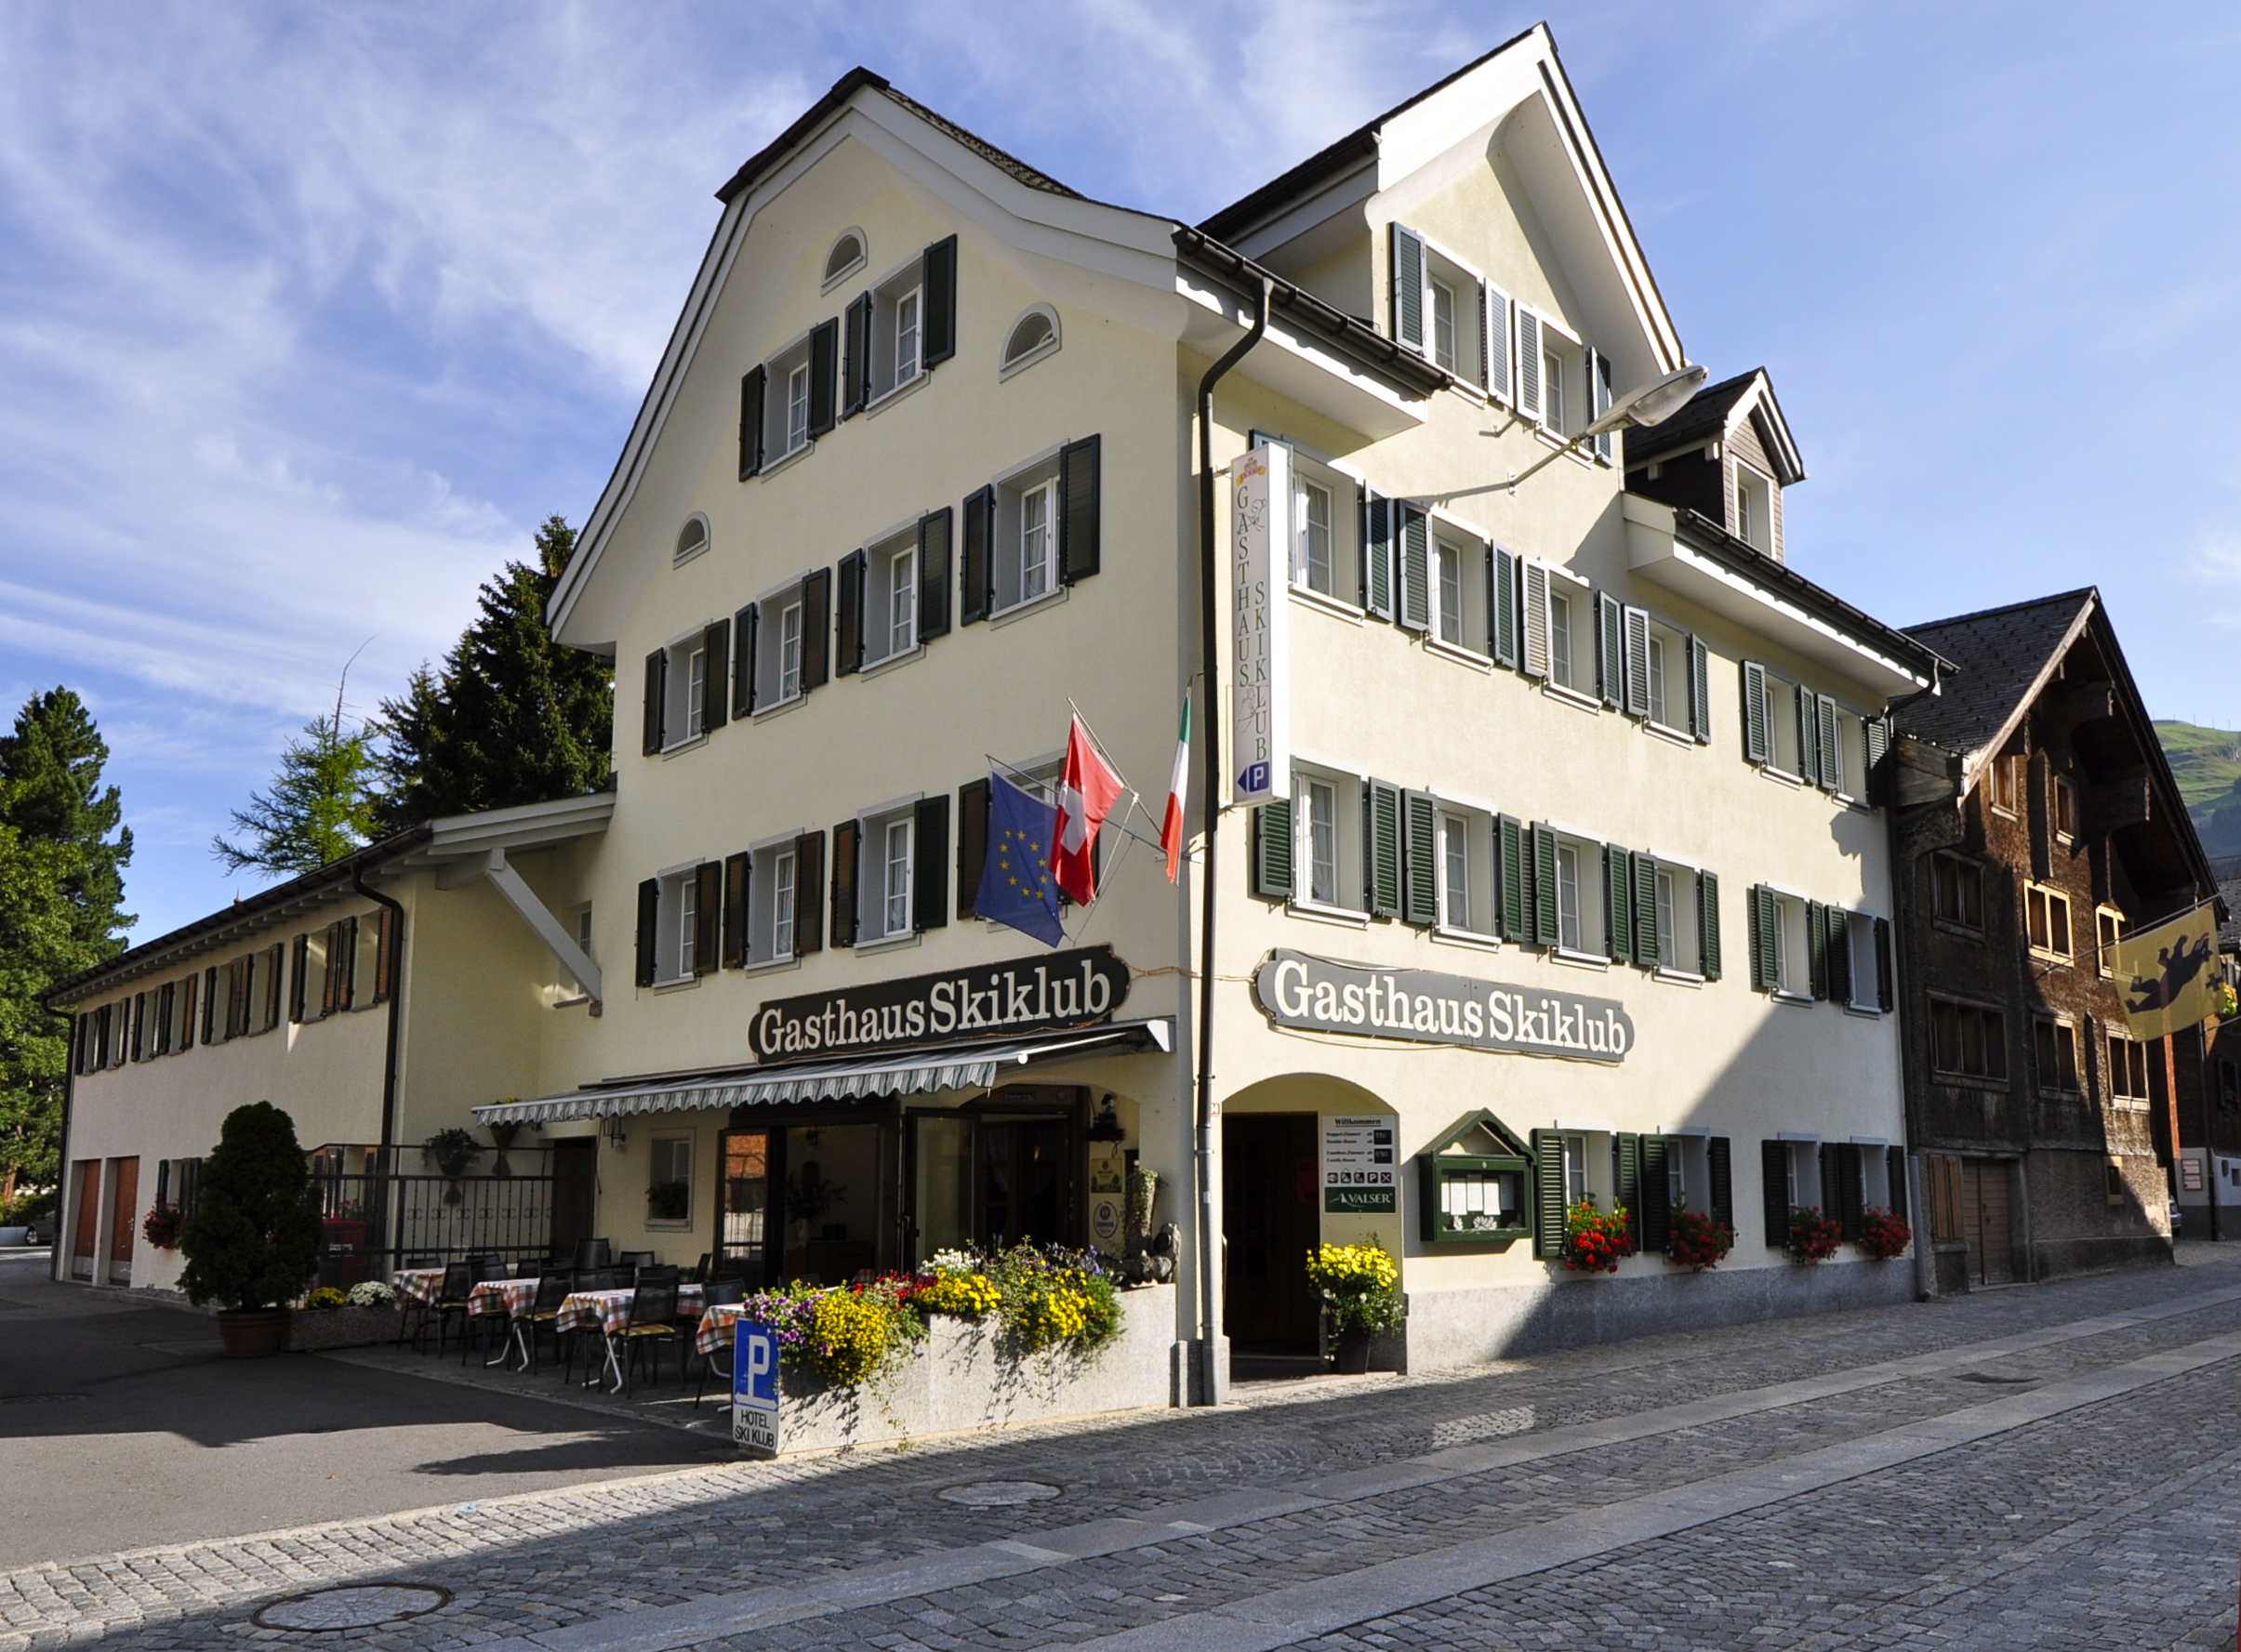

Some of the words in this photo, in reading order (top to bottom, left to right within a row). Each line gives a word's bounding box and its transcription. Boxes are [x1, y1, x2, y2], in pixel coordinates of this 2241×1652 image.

[1236, 485, 1250, 688] GASTHAUS
[1254, 580, 1267, 761] SKIKLUB
[1253, 766, 1265, 787] P
[1369, 1173, 1376, 1182] P
[1347, 1193, 1391, 1203] VALSER
[748, 1334, 770, 1396] P
[740, 1409, 770, 1429] HOTEL
[735, 1425, 749, 1441] SKI
[752, 1428, 774, 1447] KLUB
